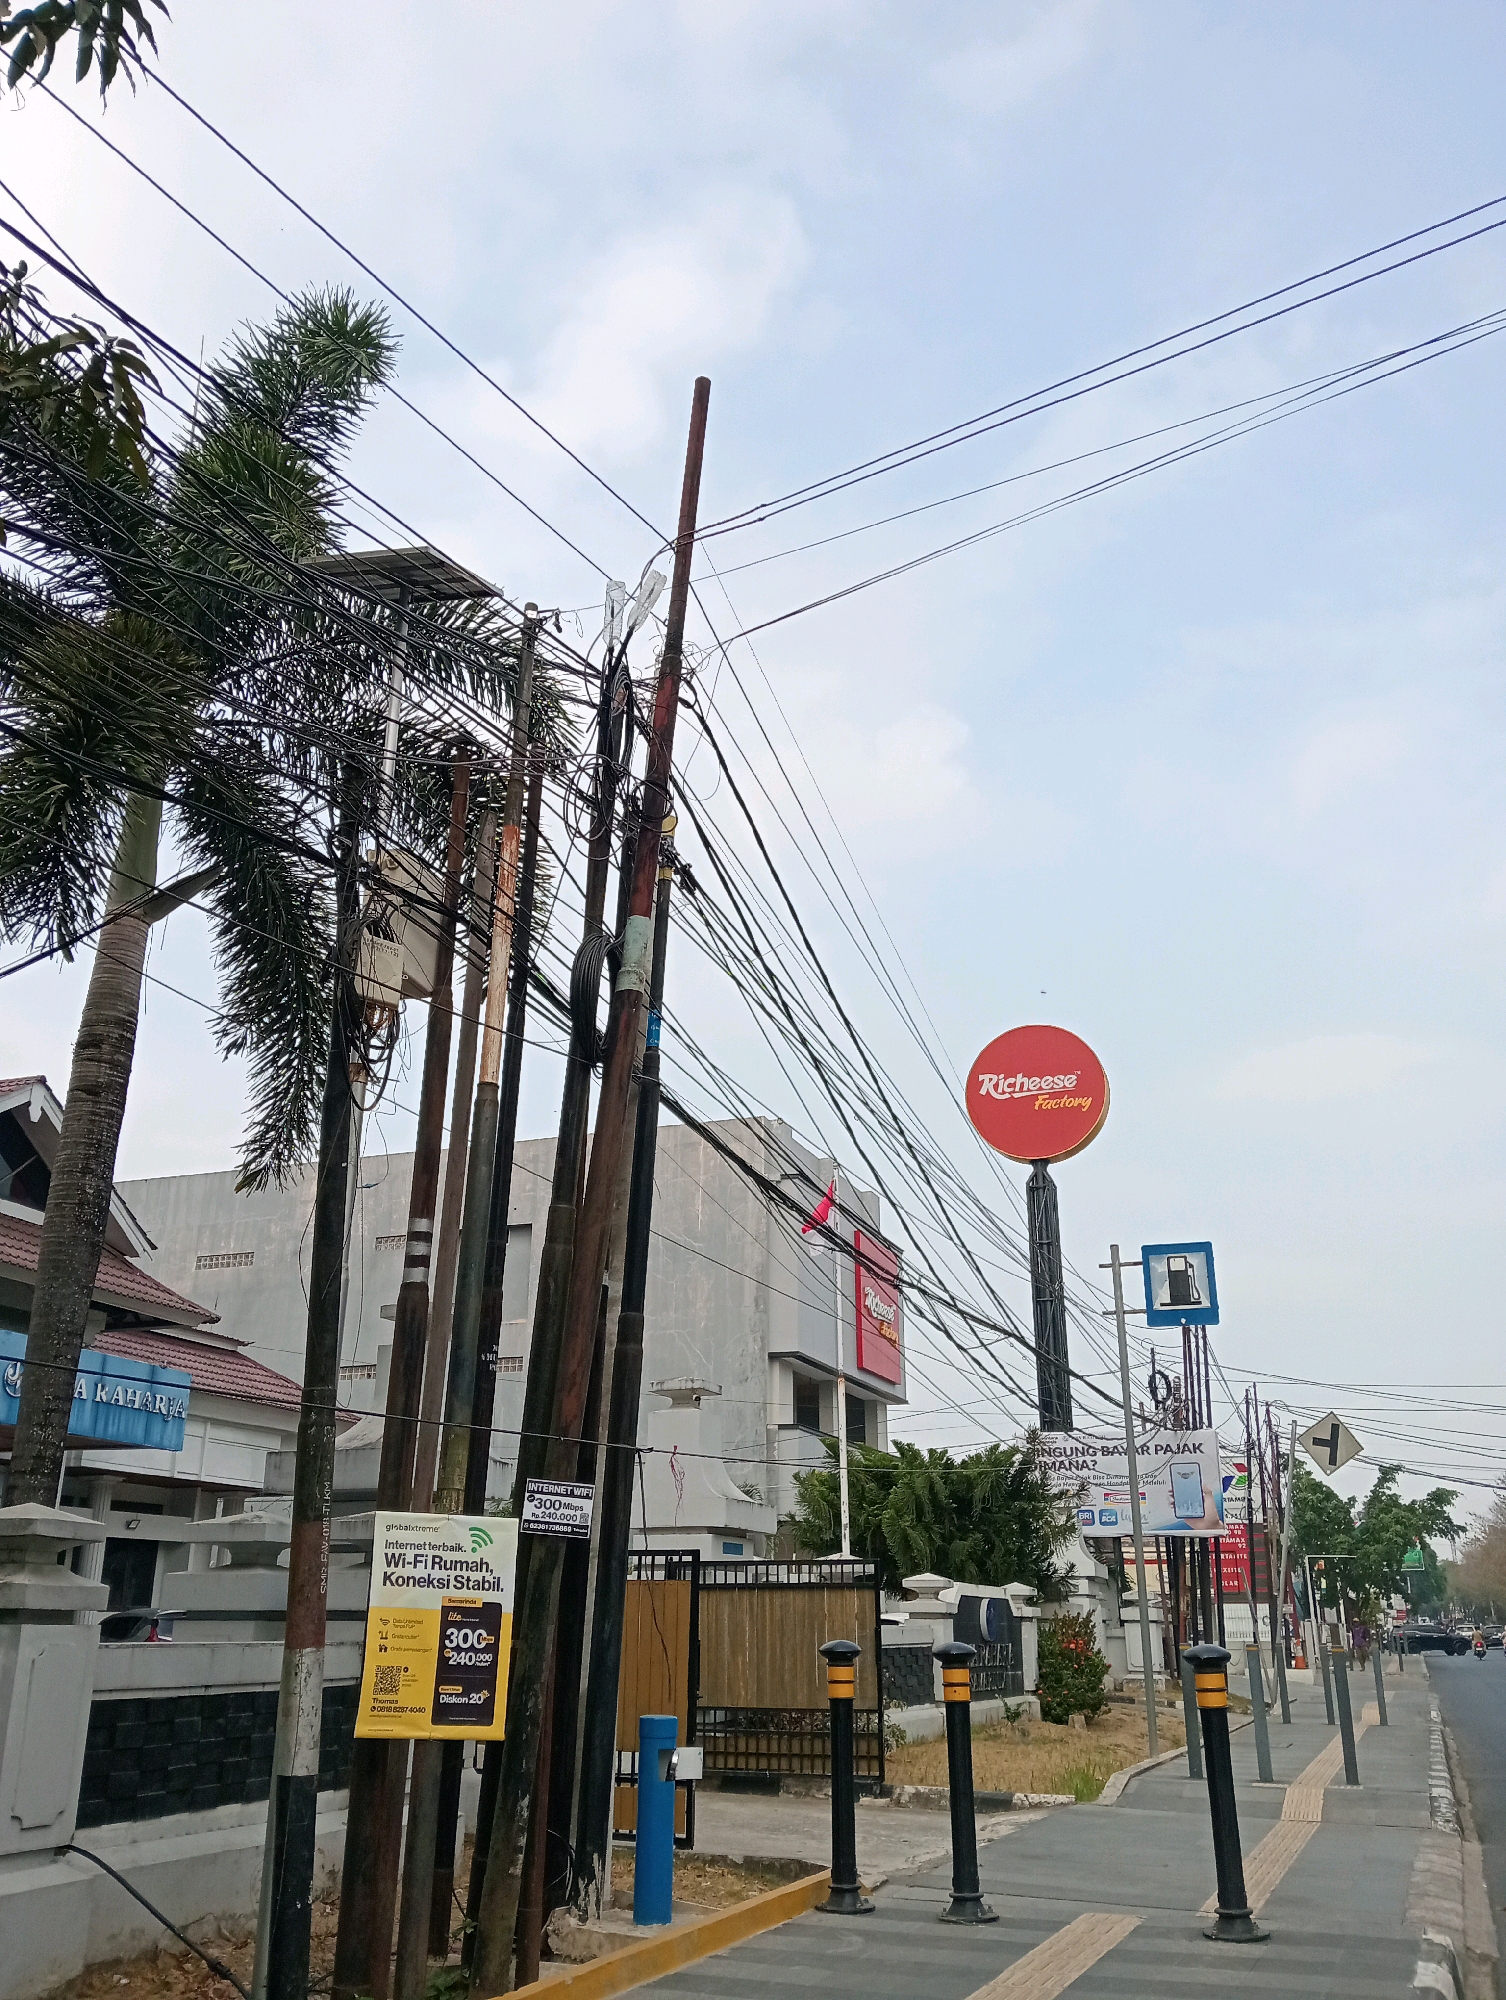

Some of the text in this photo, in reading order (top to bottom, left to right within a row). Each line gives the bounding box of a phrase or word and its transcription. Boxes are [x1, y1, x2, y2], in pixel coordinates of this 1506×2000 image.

[978, 1073, 1078, 1100] Richeese
[1034, 1094, 1093, 1112] Factory
[1154, 1442, 1205, 1455] PAJAK
[528, 1482, 593, 1497] INTERNET WIFI
[534, 1497, 584, 1513] 300 Mbps
[541, 1511, 578, 1522] 240.000
[384, 1539, 467, 1553] Internet terbaik.
[384, 1552, 494, 1576] Wi-Fi Rumah,
[382, 1571, 504, 1593] Koneksi Stabil.
[444, 1627, 488, 1649] 300
[371, 1697, 399, 1705] Thomas
[439, 1693, 469, 1704] Diskon
